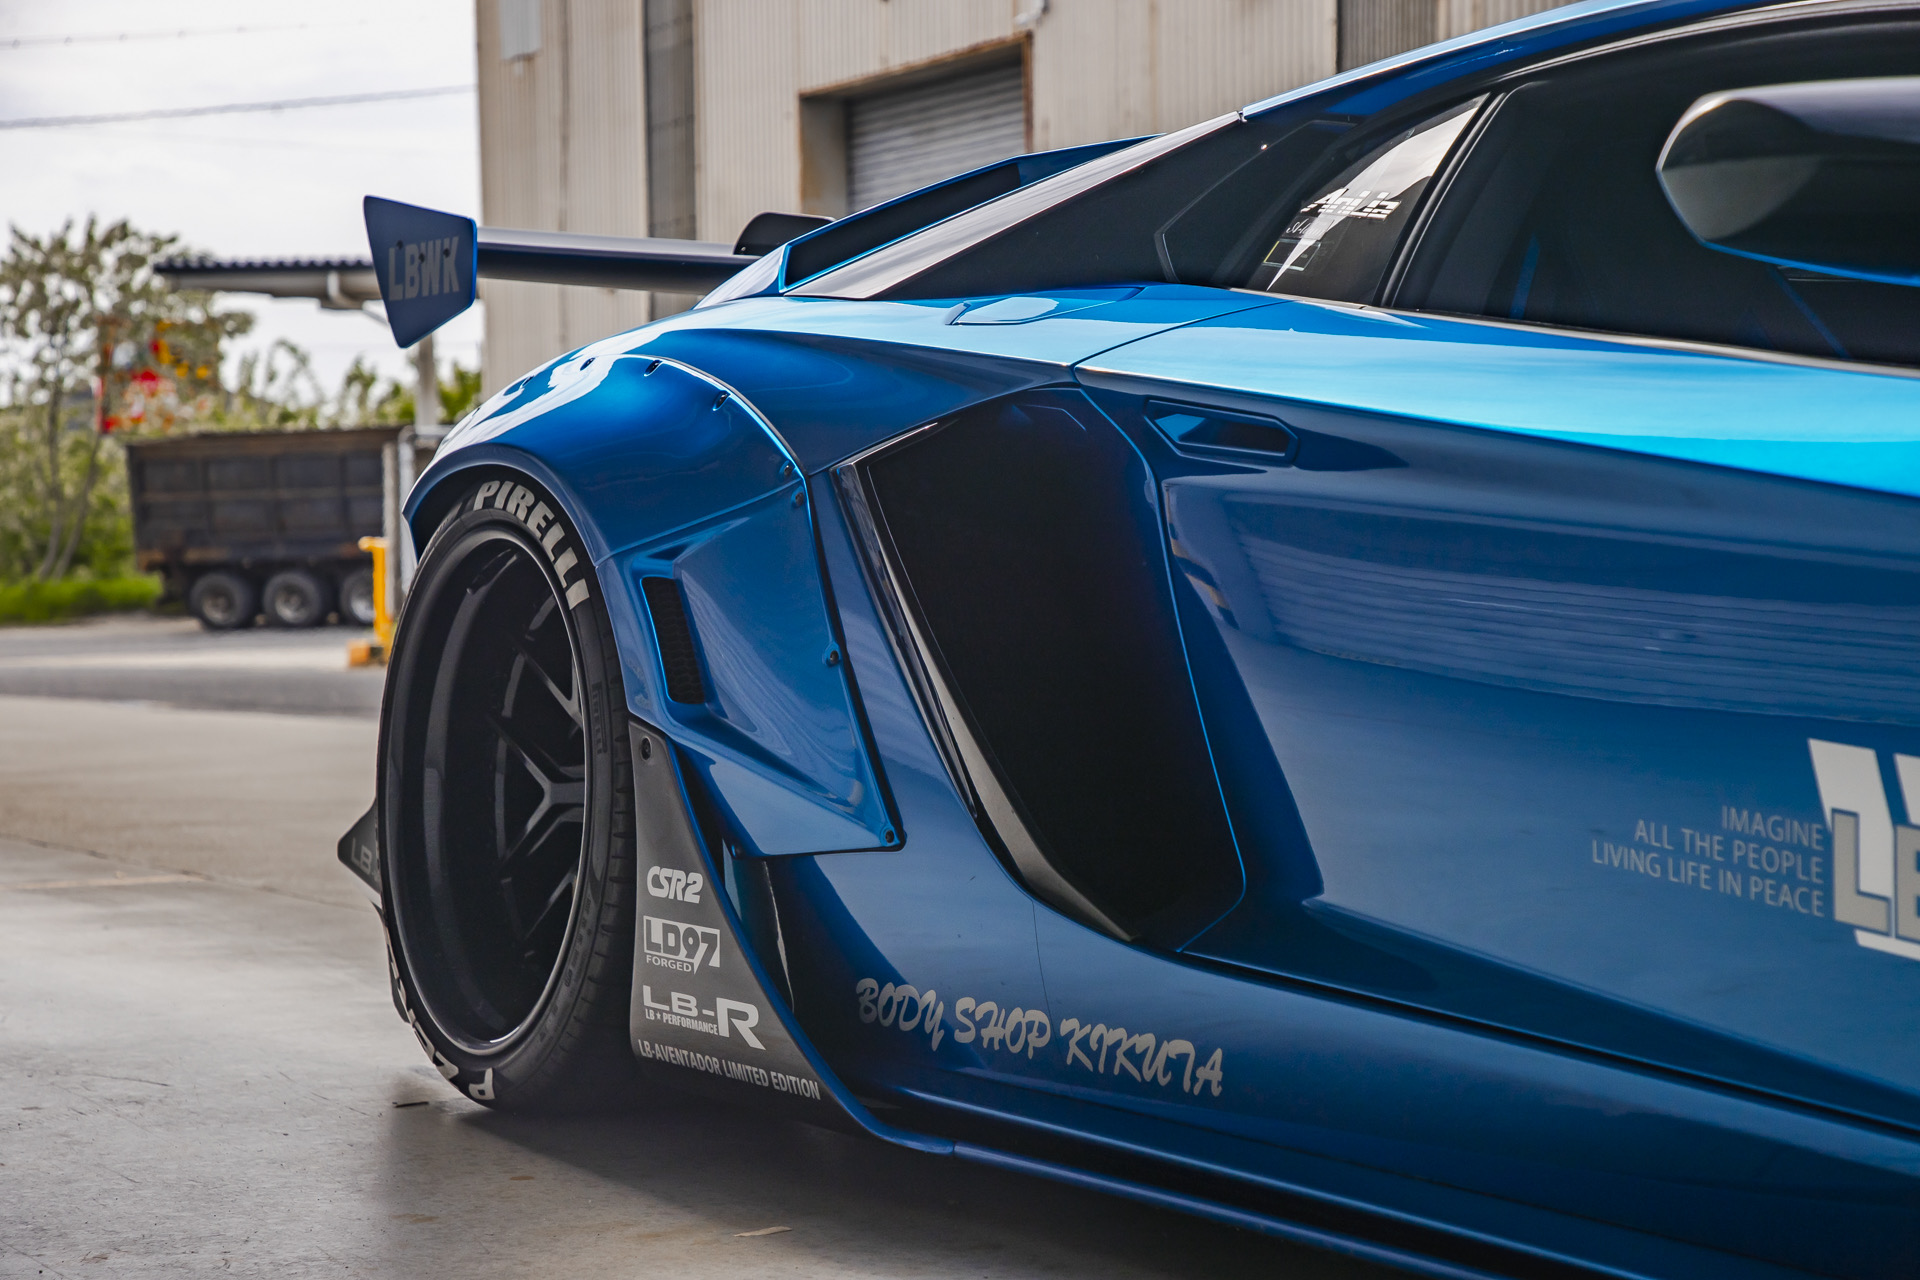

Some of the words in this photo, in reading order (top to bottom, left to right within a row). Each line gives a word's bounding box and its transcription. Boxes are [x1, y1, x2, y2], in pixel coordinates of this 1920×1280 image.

[388, 236, 460, 301] LBWK
[473, 480, 590, 610] PIRELLI
[1634, 819, 1675, 851] ALL
[1681, 828, 1725, 862] THE
[1733, 839, 1825, 884] PEOPLE
[1721, 805, 1825, 851] IMAGINE
[646, 865, 704, 904] CSR2
[1592, 839, 1662, 878] LIVING
[1667, 857, 1712, 890] LIFE
[1718, 869, 1742, 897] IN
[1750, 876, 1825, 917] PEACE
[644, 916, 720, 974] LD97
[646, 955, 692, 973] FORGED
[643, 985, 767, 1050] LB-R
[855, 978, 945, 1052] BODY
[954, 997, 1051, 1060] SHOP
[638, 1038, 721, 1075] LB-AVENTADOR
[722, 1059, 769, 1087] LIMITED
[771, 1071, 821, 1100] EDITION
